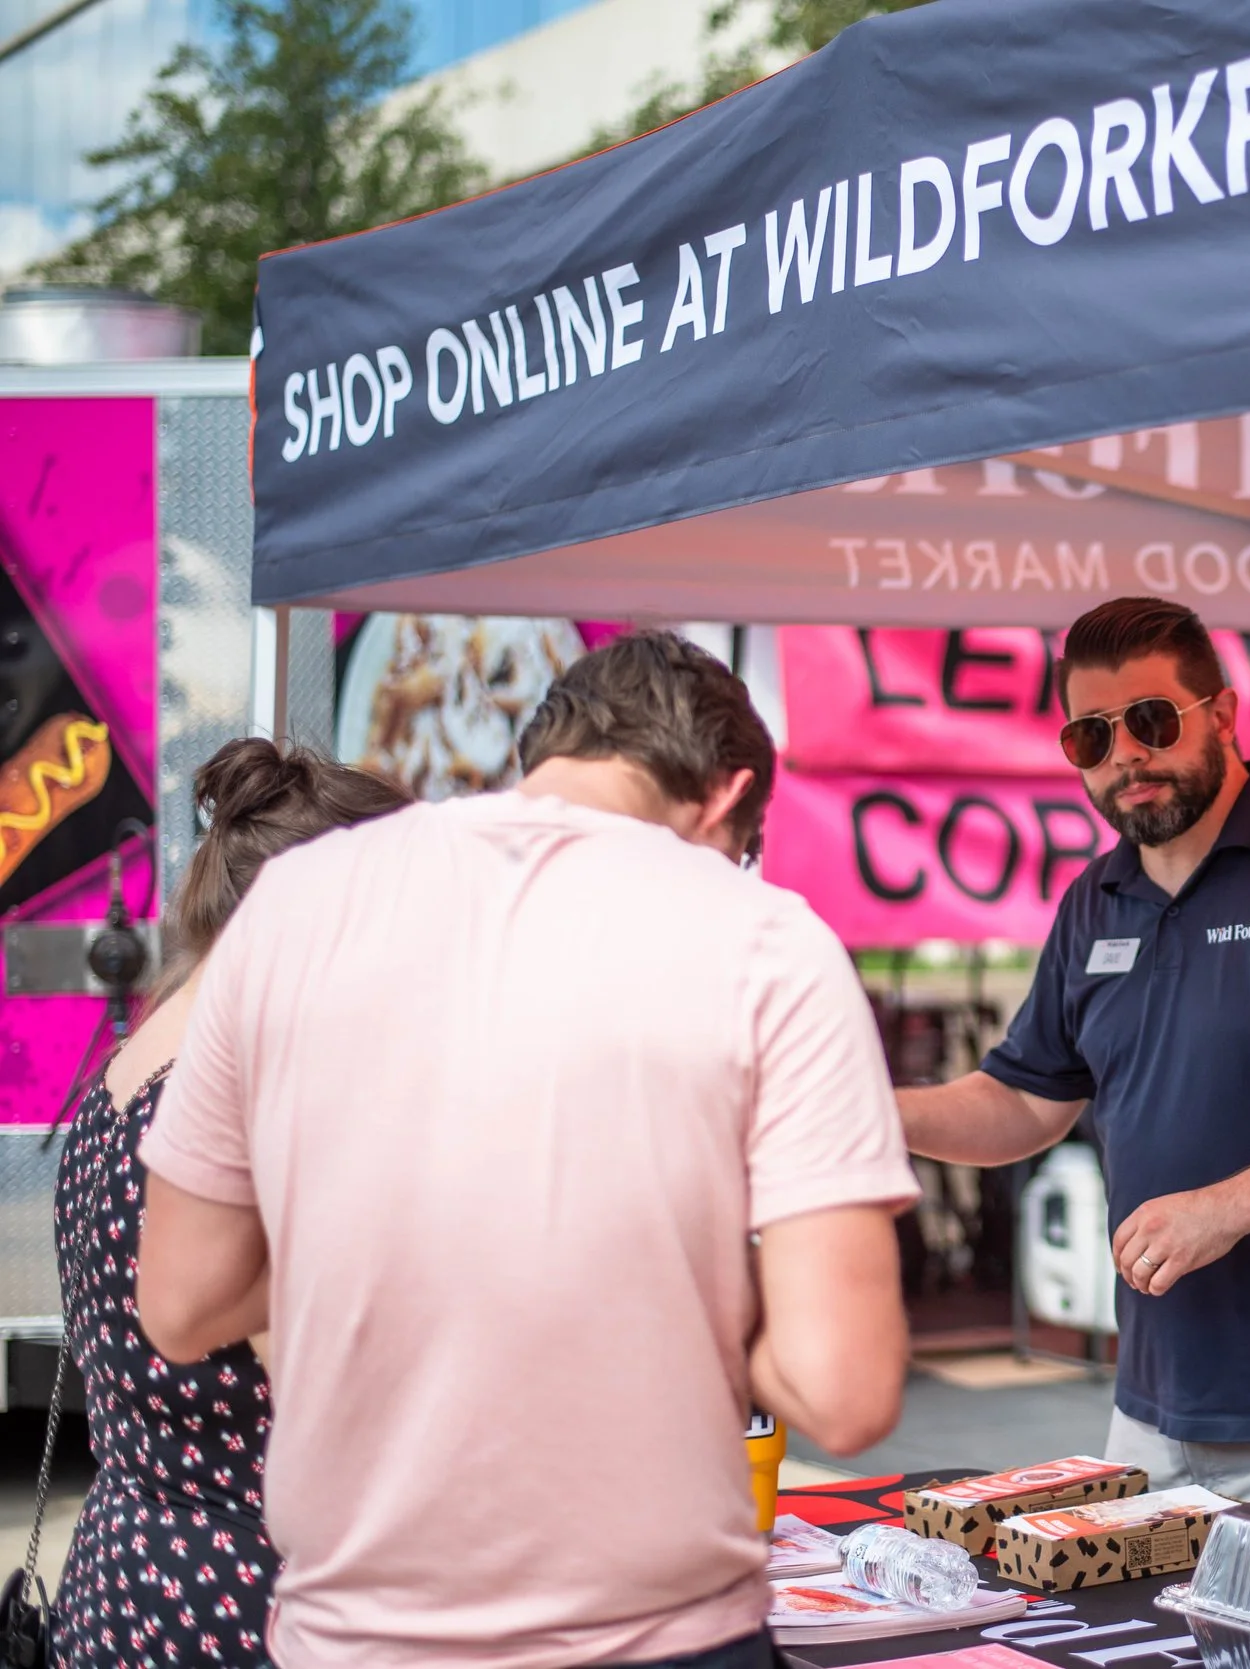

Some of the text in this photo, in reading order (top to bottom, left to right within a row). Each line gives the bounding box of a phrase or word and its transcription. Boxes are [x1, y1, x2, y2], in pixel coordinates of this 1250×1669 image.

[281, 344, 412, 463] SHOP
[426, 262, 645, 424] ONLINE
[659, 222, 748, 354] AT
